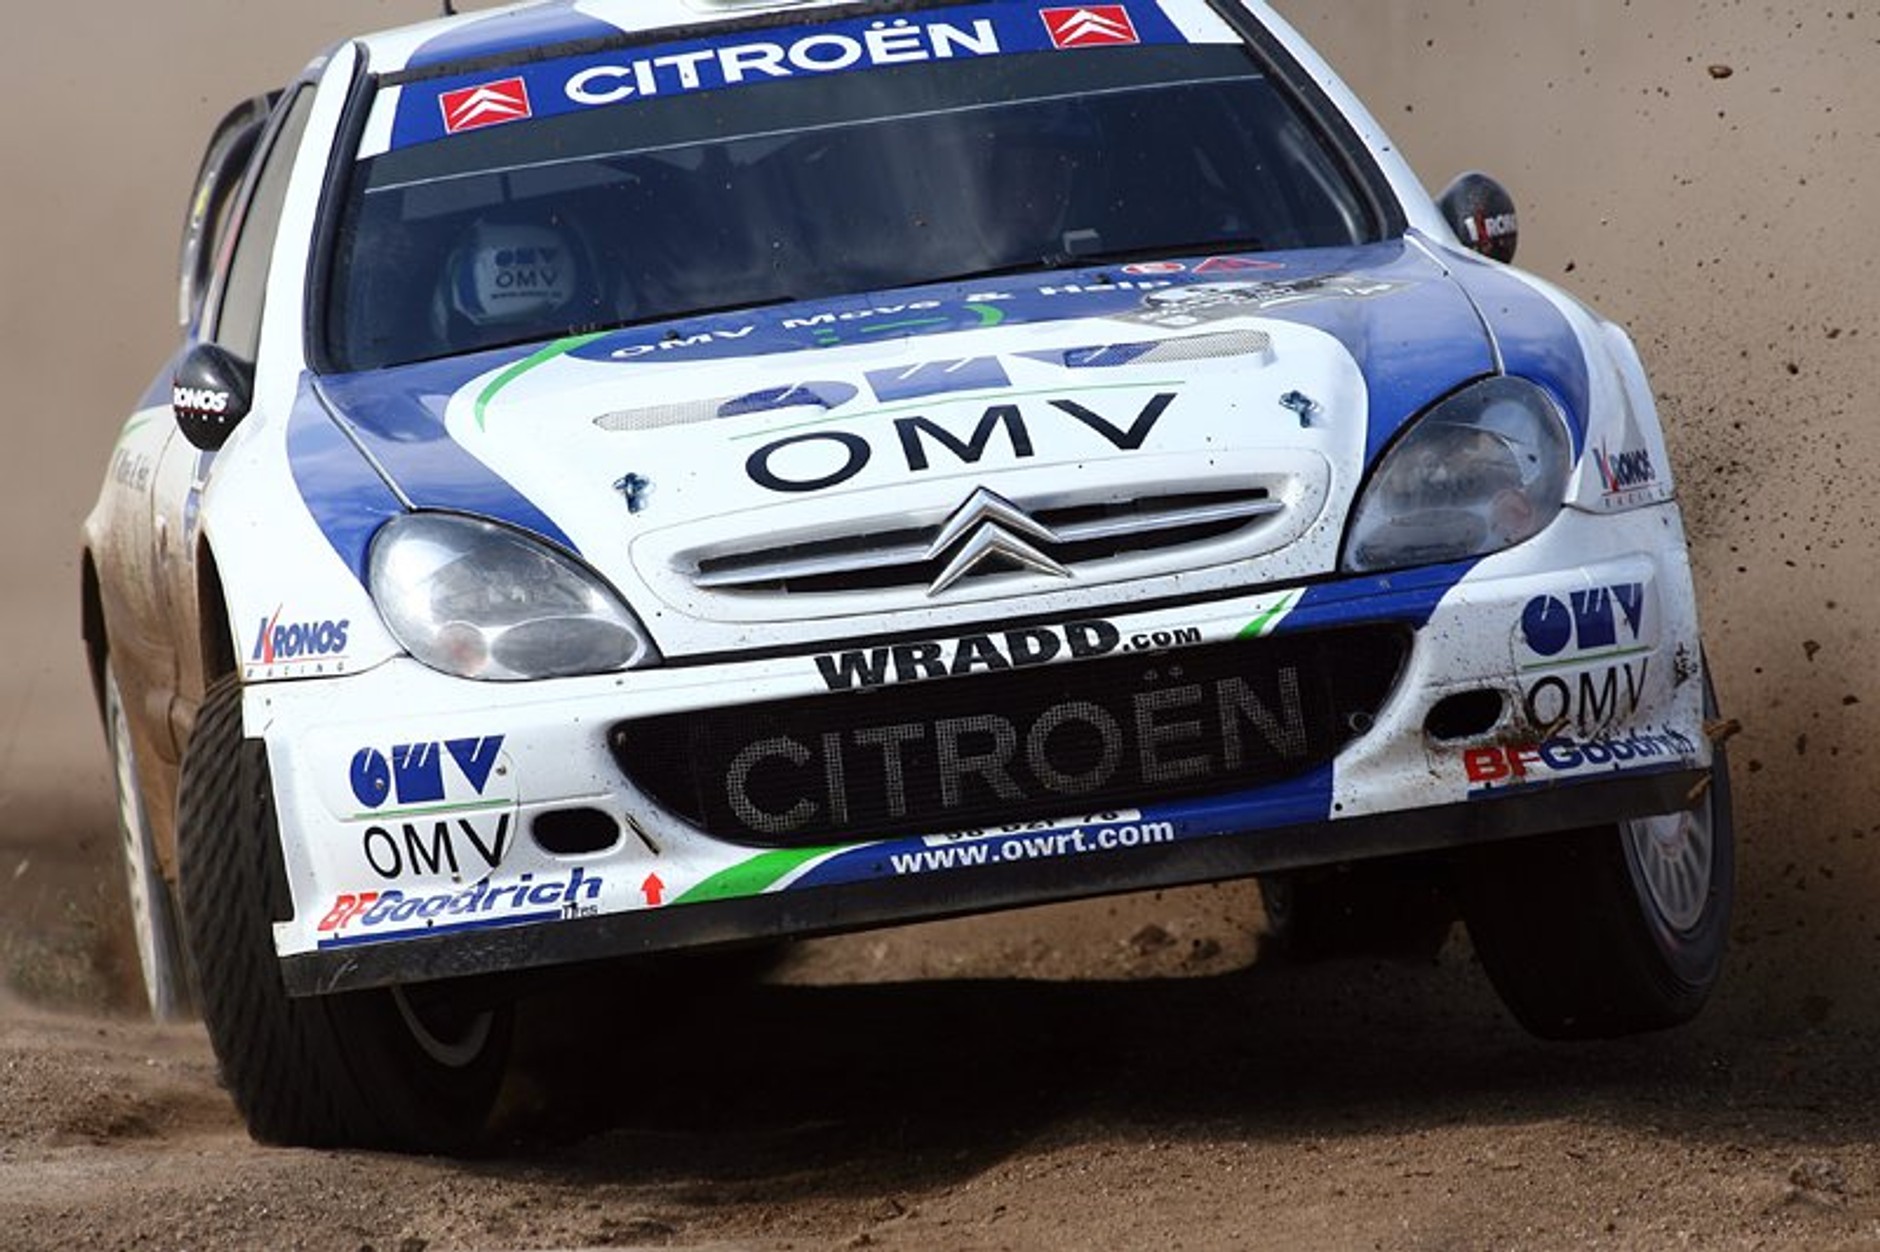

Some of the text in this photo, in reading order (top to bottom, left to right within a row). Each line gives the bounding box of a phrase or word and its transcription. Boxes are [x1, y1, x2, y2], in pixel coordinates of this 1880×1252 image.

[564, 19, 1000, 104] CITROËN
[496, 270, 558, 288] OMV
[611, 325, 755, 358] OMV
[782, 301, 941, 329] Move
[1039, 281, 1172, 296] Help
[745, 392, 1178, 492] OMV
[1592, 436, 1656, 493] KRONOS
[252, 602, 350, 664] KRONOS
[1526, 658, 1649, 740] OMV
[725, 664, 1308, 834] CITROËN
[1464, 722, 1696, 783] BFGoodrich
[363, 813, 511, 880] OMV
[890, 821, 1174, 875] www.owrt.com
[317, 867, 604, 932] BFGoodrich
